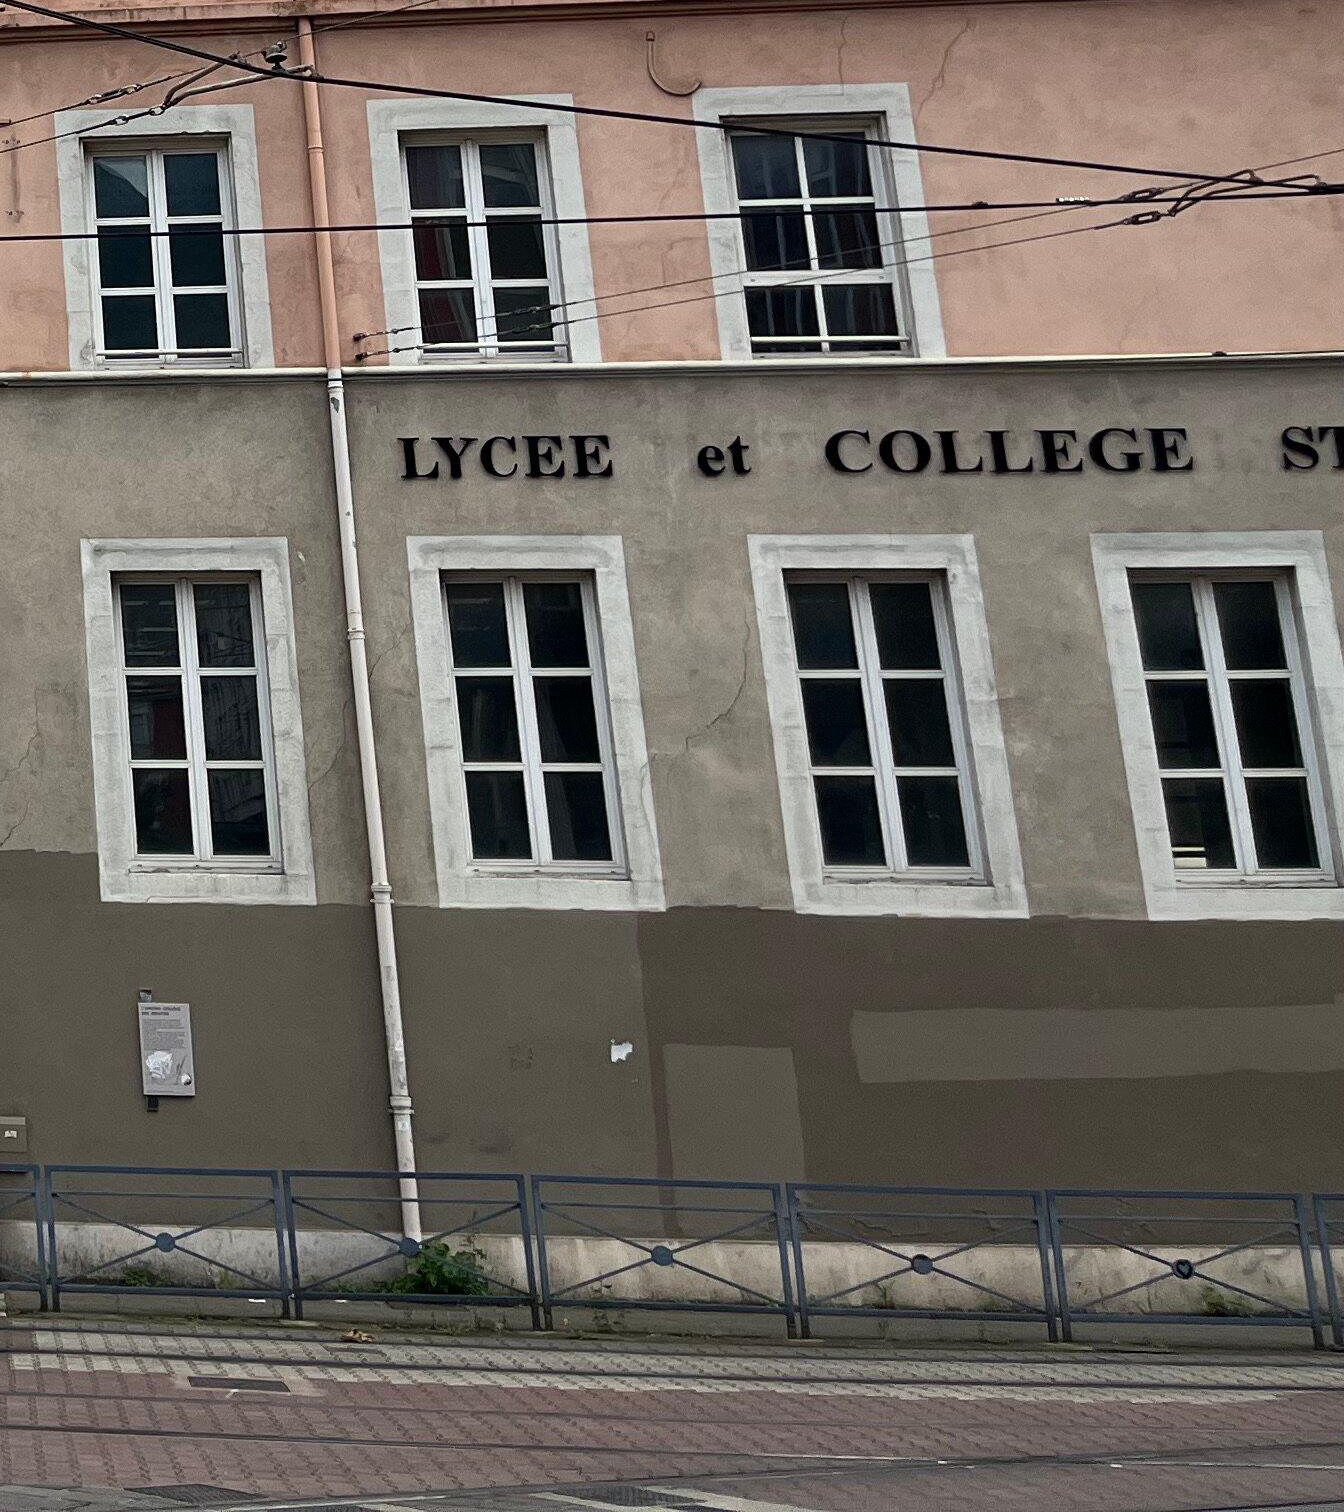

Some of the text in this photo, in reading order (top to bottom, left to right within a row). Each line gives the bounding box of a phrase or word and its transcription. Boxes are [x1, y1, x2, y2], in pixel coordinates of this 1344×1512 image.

[397, 435, 613, 480] LYCEE
[697, 435, 752, 477] et
[824, 427, 1194, 474] COLLEGE
